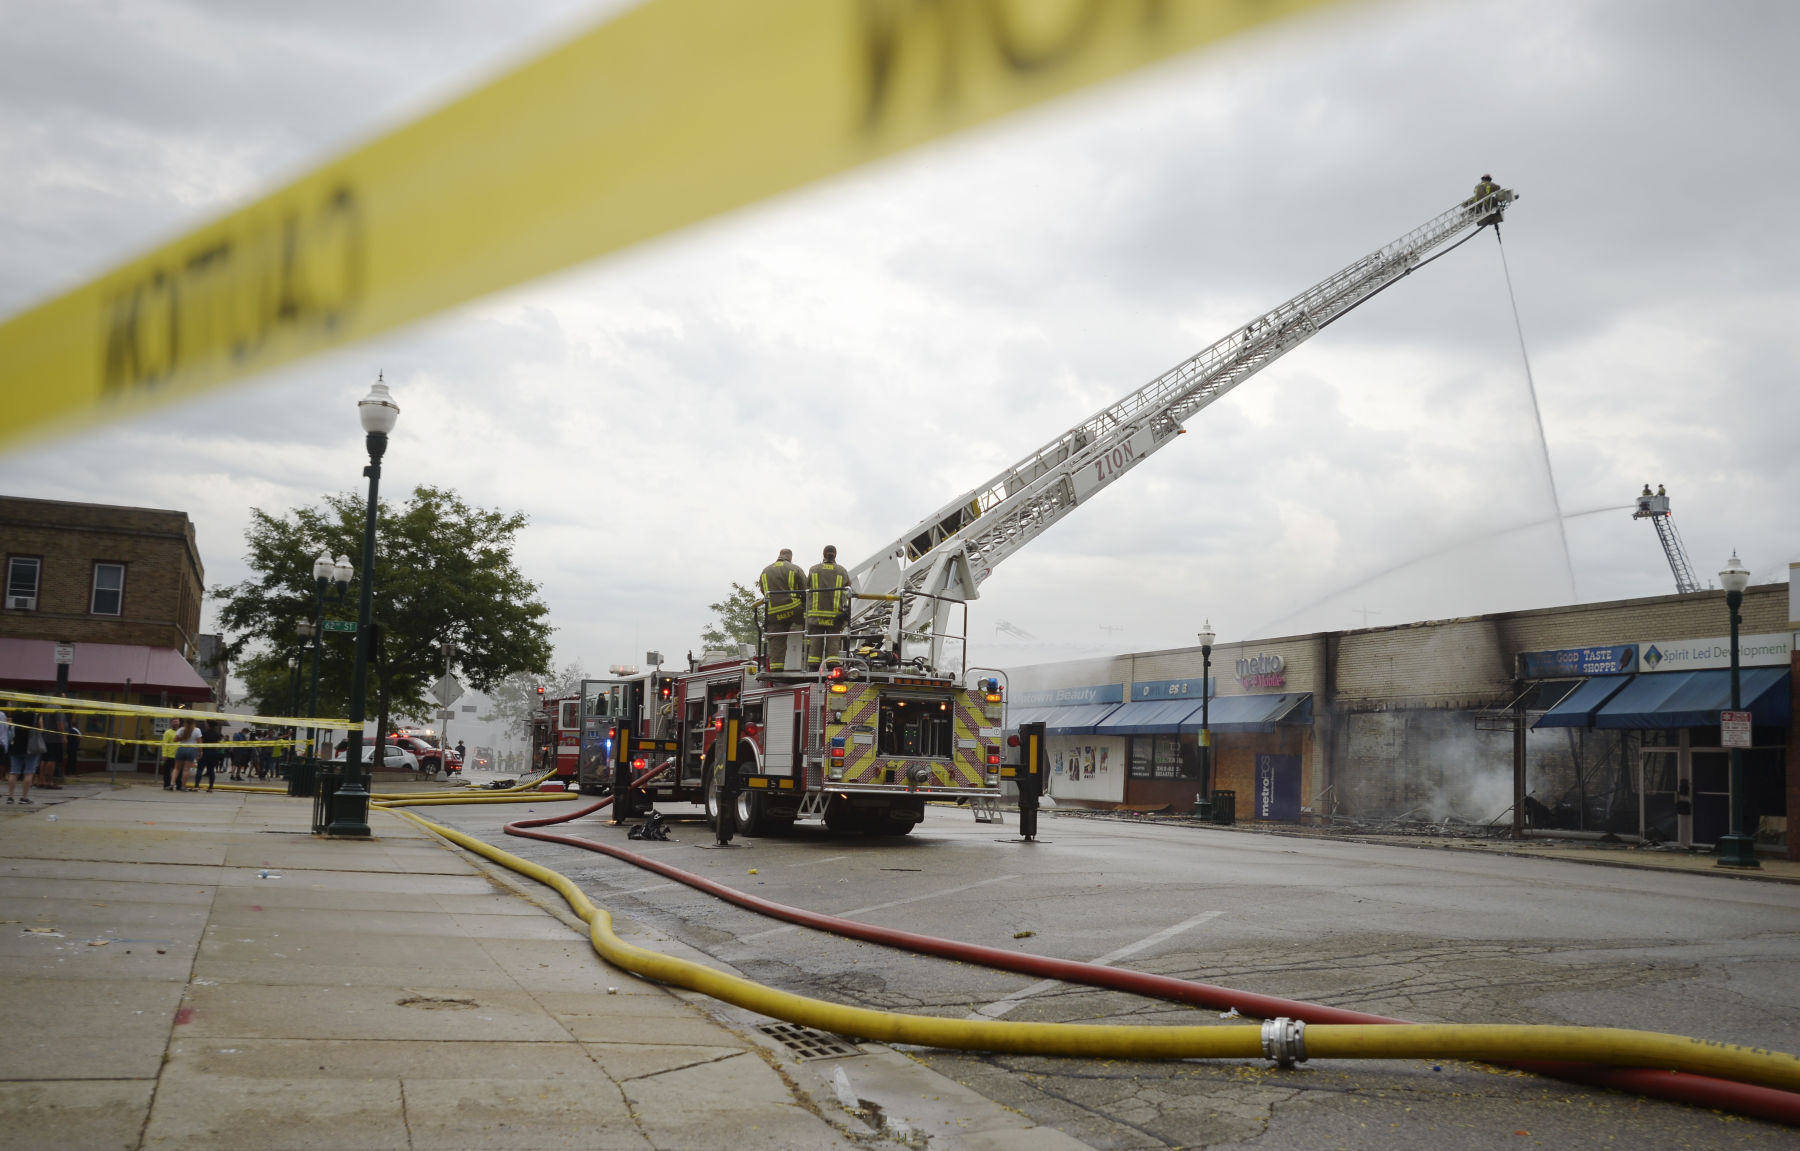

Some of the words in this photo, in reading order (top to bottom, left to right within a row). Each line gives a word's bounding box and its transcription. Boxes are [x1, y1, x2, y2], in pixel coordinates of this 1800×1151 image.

[1094, 440, 1135, 482] ZION
[343, 622, 354, 631] ST
[1663, 649, 1689, 665] Spirit
[1692, 647, 1711, 659] Led
[1713, 643, 1787, 661] Devlopment
[1236, 652, 1282, 685] metro
[1583, 661, 1617, 673] SHOPPE
[1055, 687, 1097, 702] Beauty
[1260, 755, 1271, 817] metroPCS
